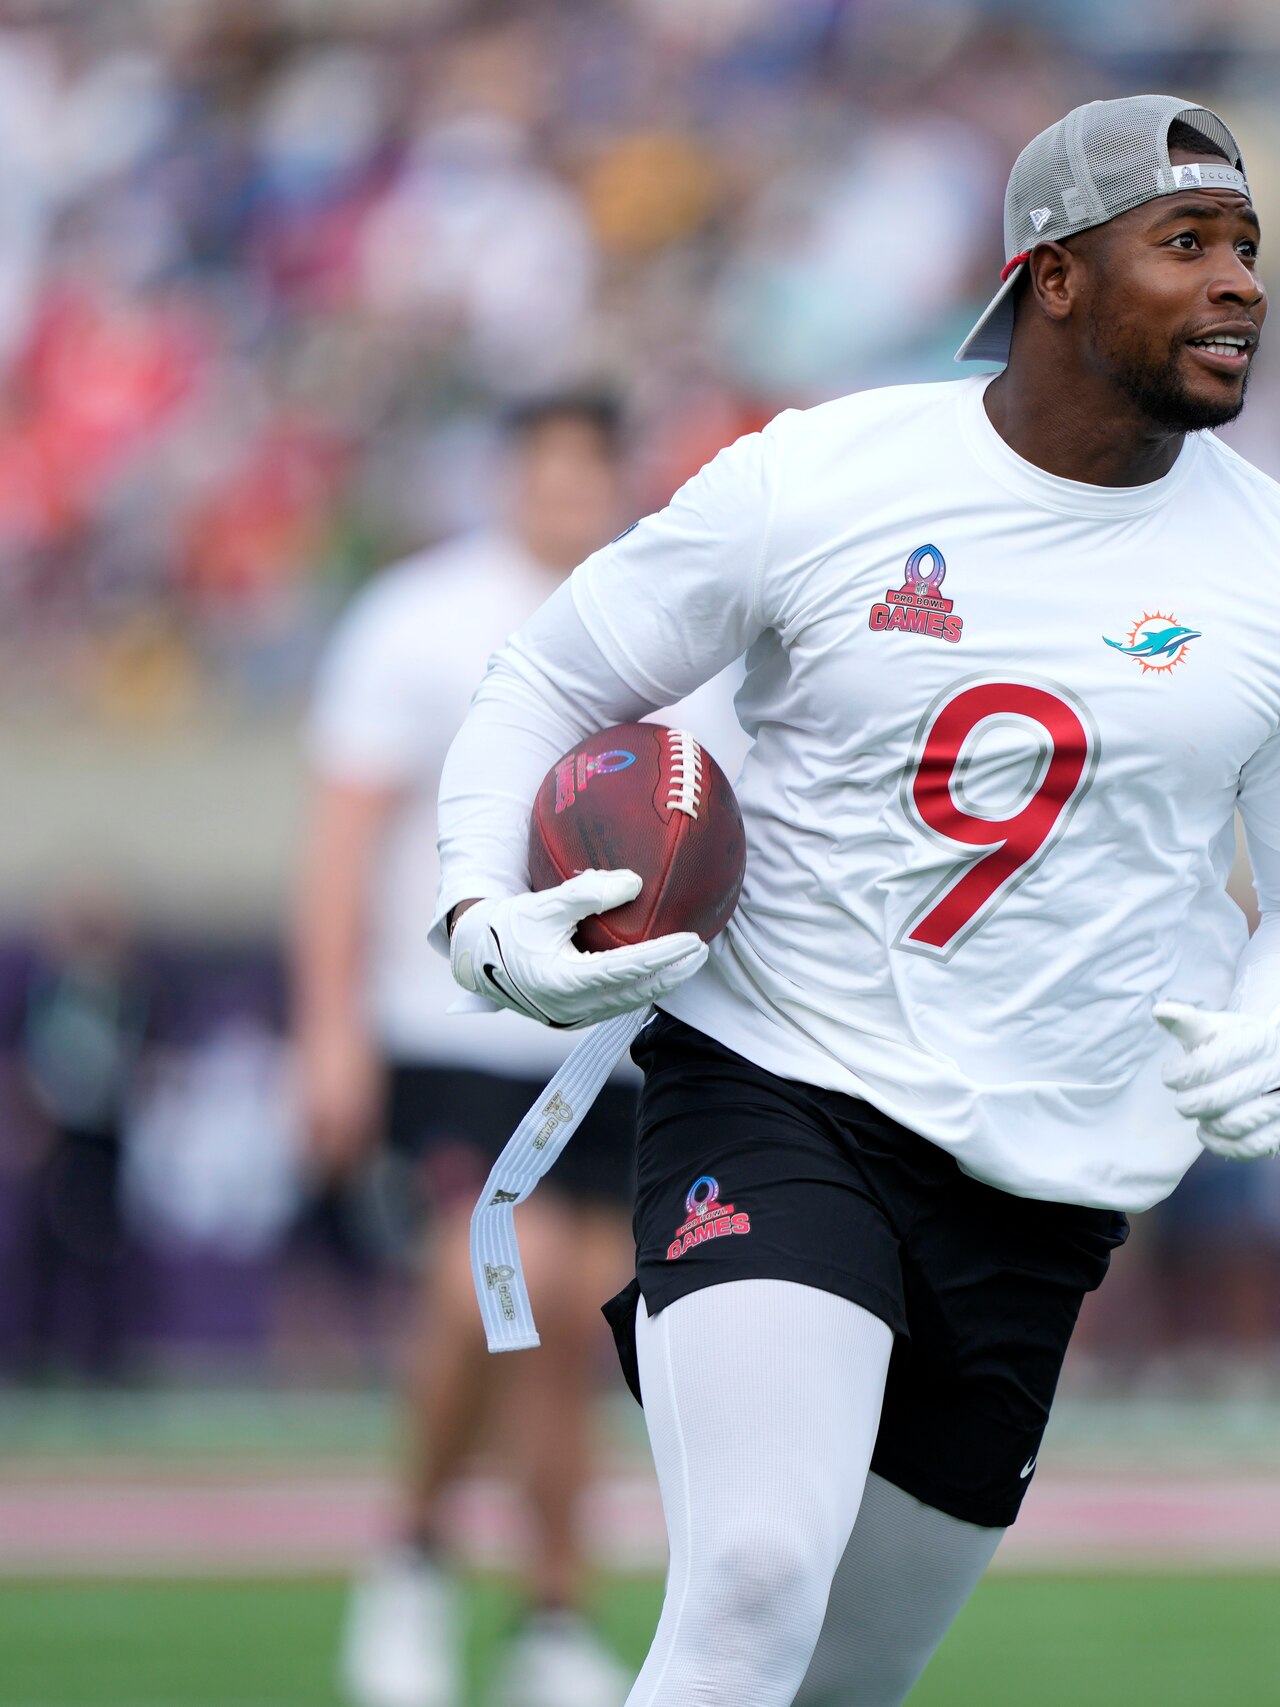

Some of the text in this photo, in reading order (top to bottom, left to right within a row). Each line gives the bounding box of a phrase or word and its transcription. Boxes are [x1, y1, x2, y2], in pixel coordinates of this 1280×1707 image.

[893, 593, 945, 609] PRO BOWL
[869, 603, 963, 643] GAMES
[891, 669, 1101, 964] 9
[700, 1207, 728, 1222] BOWL
[666, 1213, 750, 1260] GAMES
